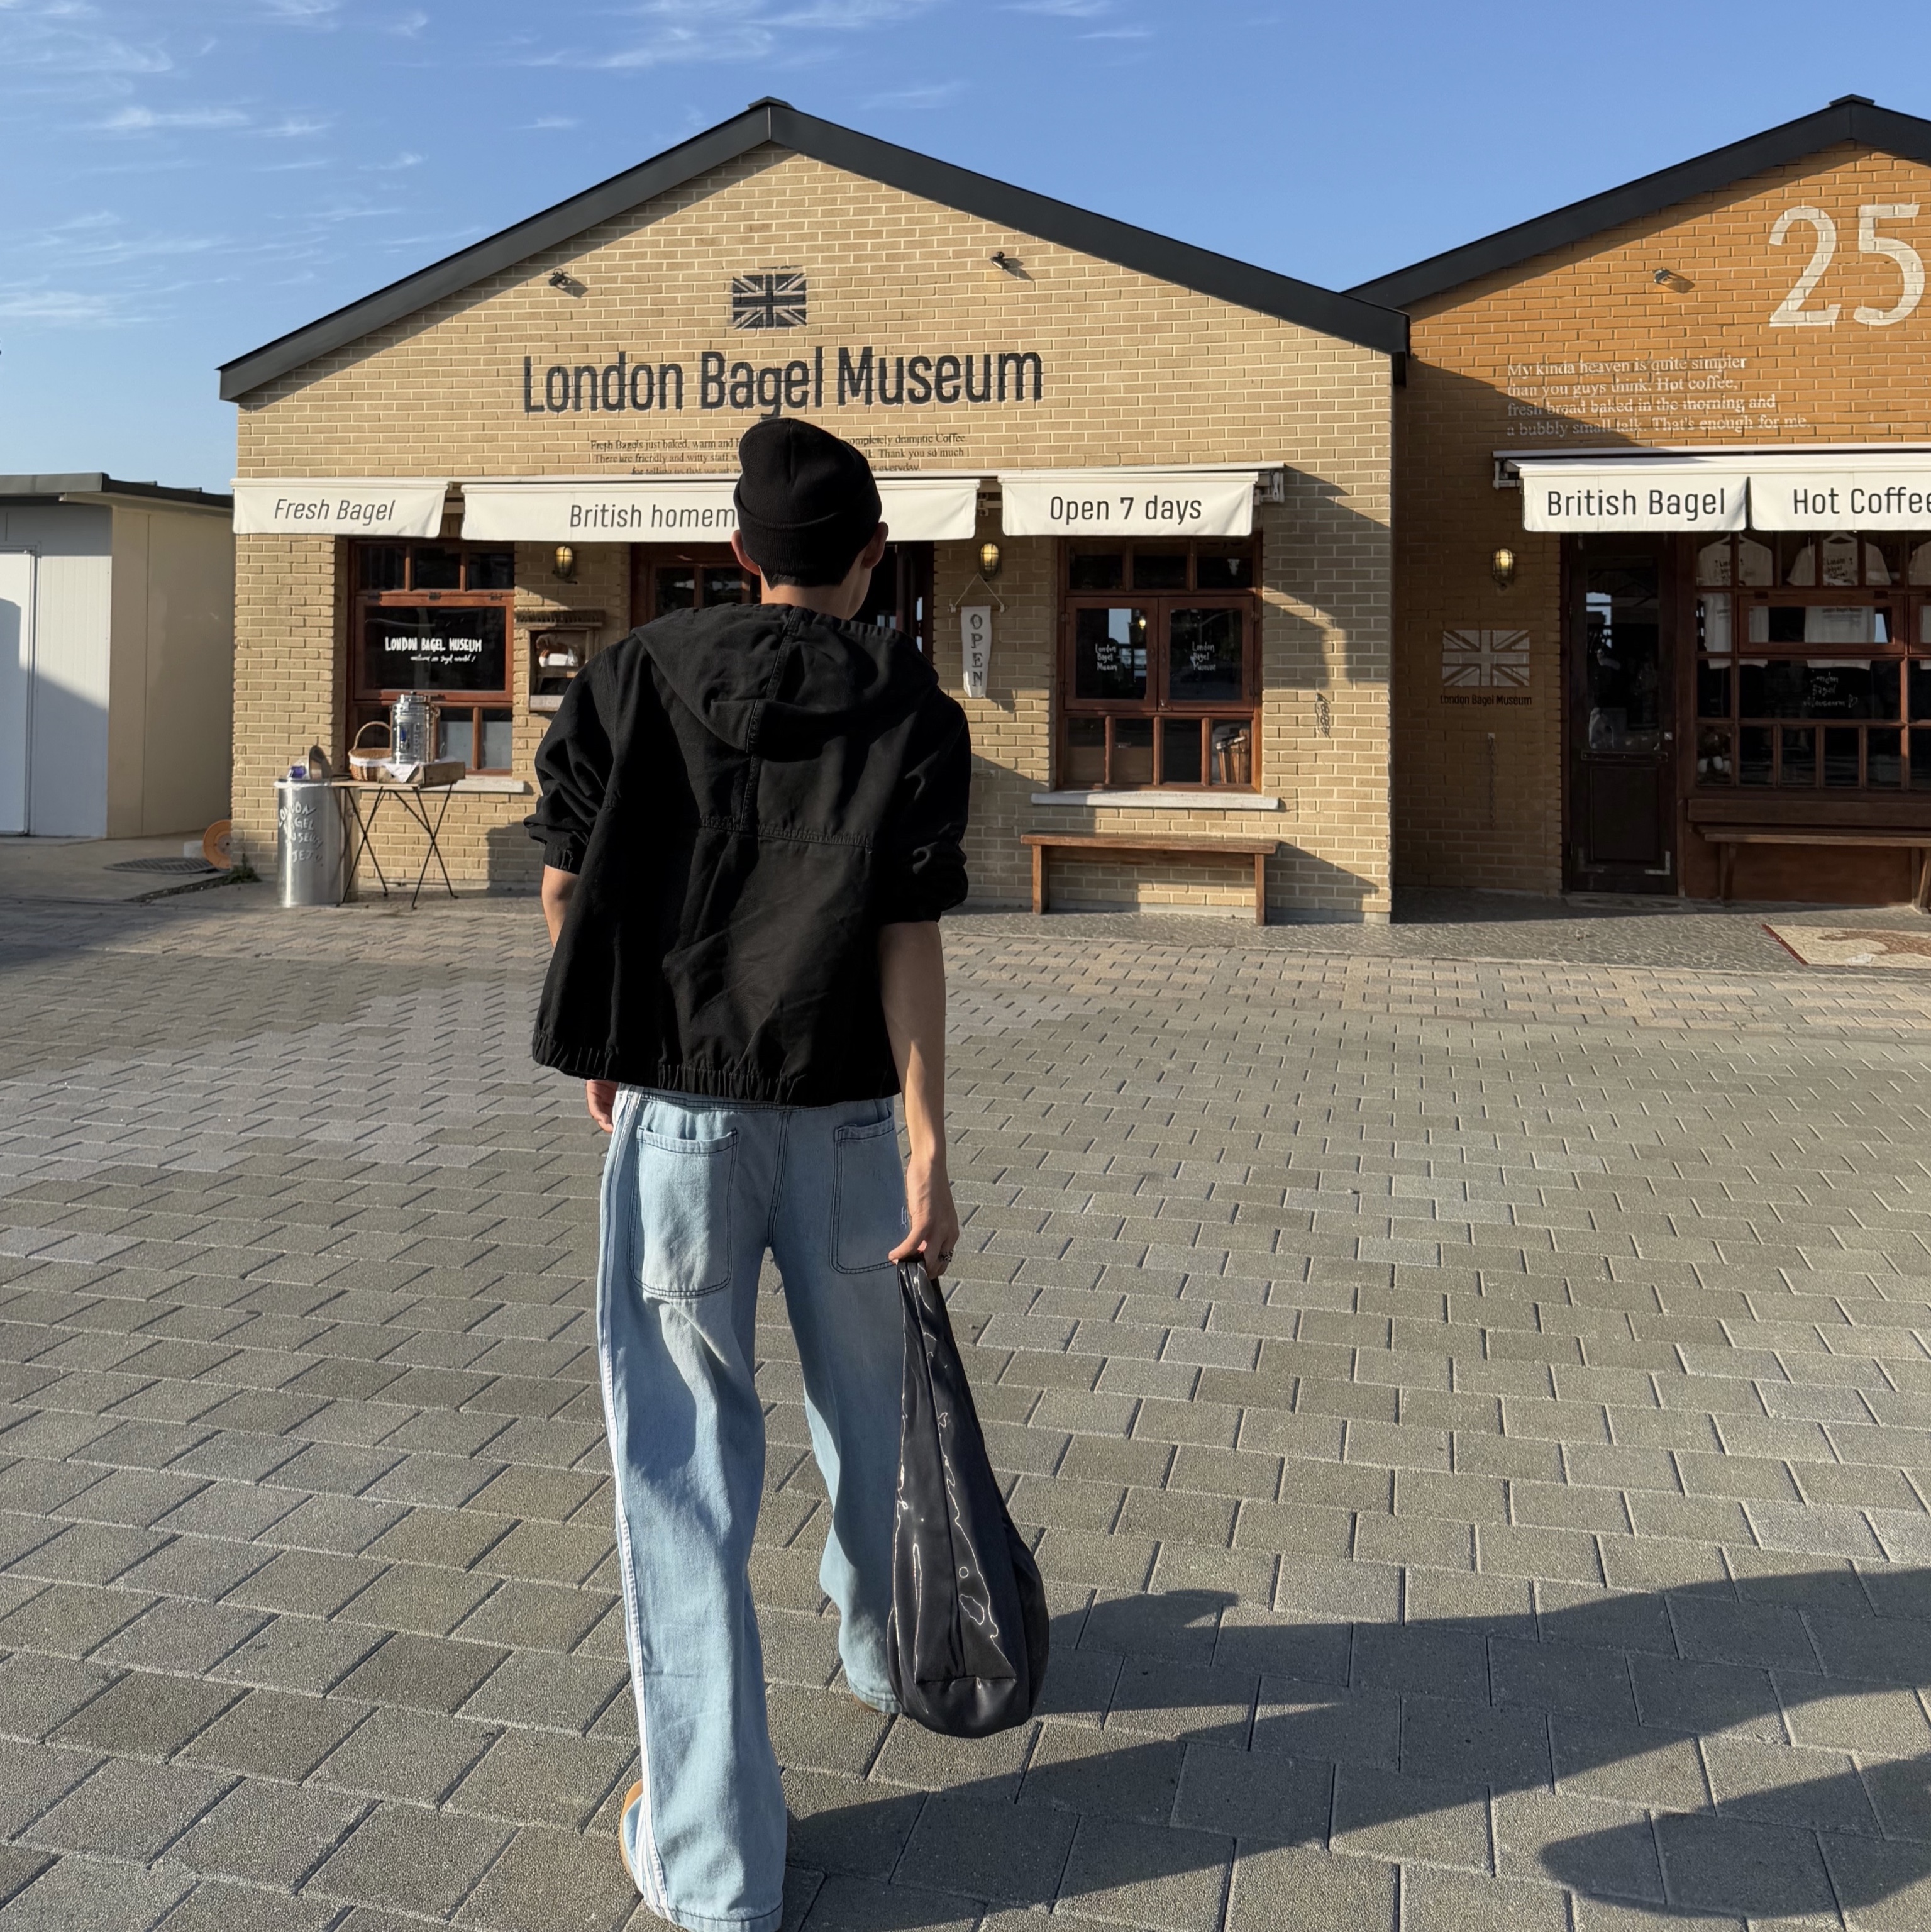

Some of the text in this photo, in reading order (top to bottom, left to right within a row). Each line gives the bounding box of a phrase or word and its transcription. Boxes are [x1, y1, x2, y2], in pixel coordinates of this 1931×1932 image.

[1769, 203, 1925, 327] 25
[1507, 354, 1747, 379] My kinda heaven is quite simpler
[524, 346, 1043, 420] London Bagel Museum
[1507, 375, 1739, 399] than you guys think. Hot coffee,
[1507, 393, 1776, 416] fresh bread baked in the morning and
[1507, 414, 1812, 438] a bubbly small talk. That's enough for me.
[645, 440, 661, 451] just
[692, 440, 716, 450] warm
[718, 438, 733, 449] and
[895, 434, 933, 444] dramatic
[594, 453, 618, 464] There
[635, 452, 667, 465] friendly
[670, 452, 684, 462] and
[687, 452, 708, 464] witty
[711, 451, 729, 462] staff
[880, 448, 905, 458] Thank
[909, 450, 925, 461] you
[939, 447, 964, 457] much
[274, 498, 396, 526] Fresh Bagel
[1050, 494, 1202, 526] Open 7 days
[1547, 487, 1725, 521] British Bagel
[1793, 487, 1840, 514] Hot
[570, 503, 736, 528] British homem
[385, 636, 482, 652] LONDON BAGEL MUSEUM
[970, 613, 983, 687] OPEN
[1440, 694, 1532, 706] London Bagel Museum
